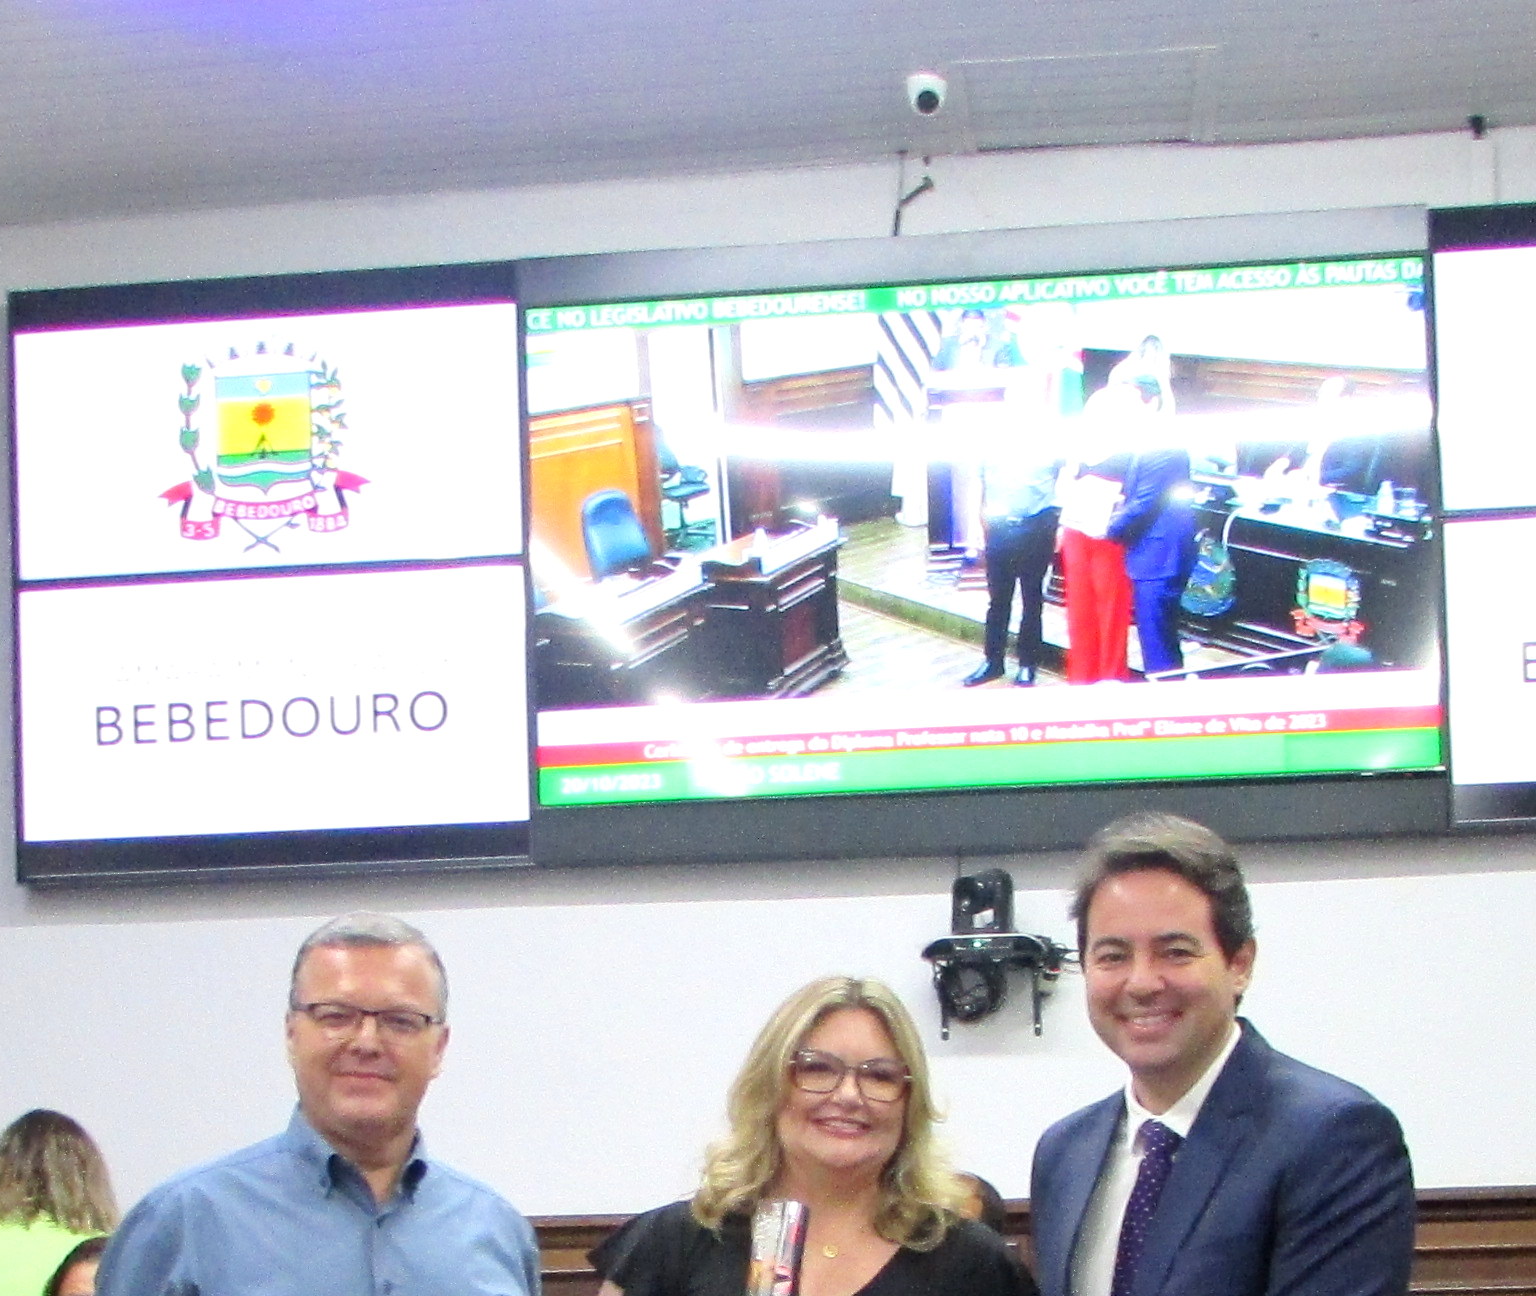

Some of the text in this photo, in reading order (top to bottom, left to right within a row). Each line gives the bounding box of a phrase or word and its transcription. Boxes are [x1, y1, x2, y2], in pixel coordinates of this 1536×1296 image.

[896, 292, 926, 308] NO
[931, 286, 996, 306] NOSSO
[998, 278, 1110, 302] APLICATIVO
[1115, 270, 1168, 295] VOCÊ
[1171, 274, 1214, 293] TEM
[1216, 268, 1291, 290] ACESSO
[1324, 262, 1397, 284] PAUTAS
[556, 310, 586, 329] NO
[590, 302, 709, 328] LEGISLATIVO
[214, 496, 315, 518] BEBEDOURO
[95, 690, 448, 746] BEBEDOURO
